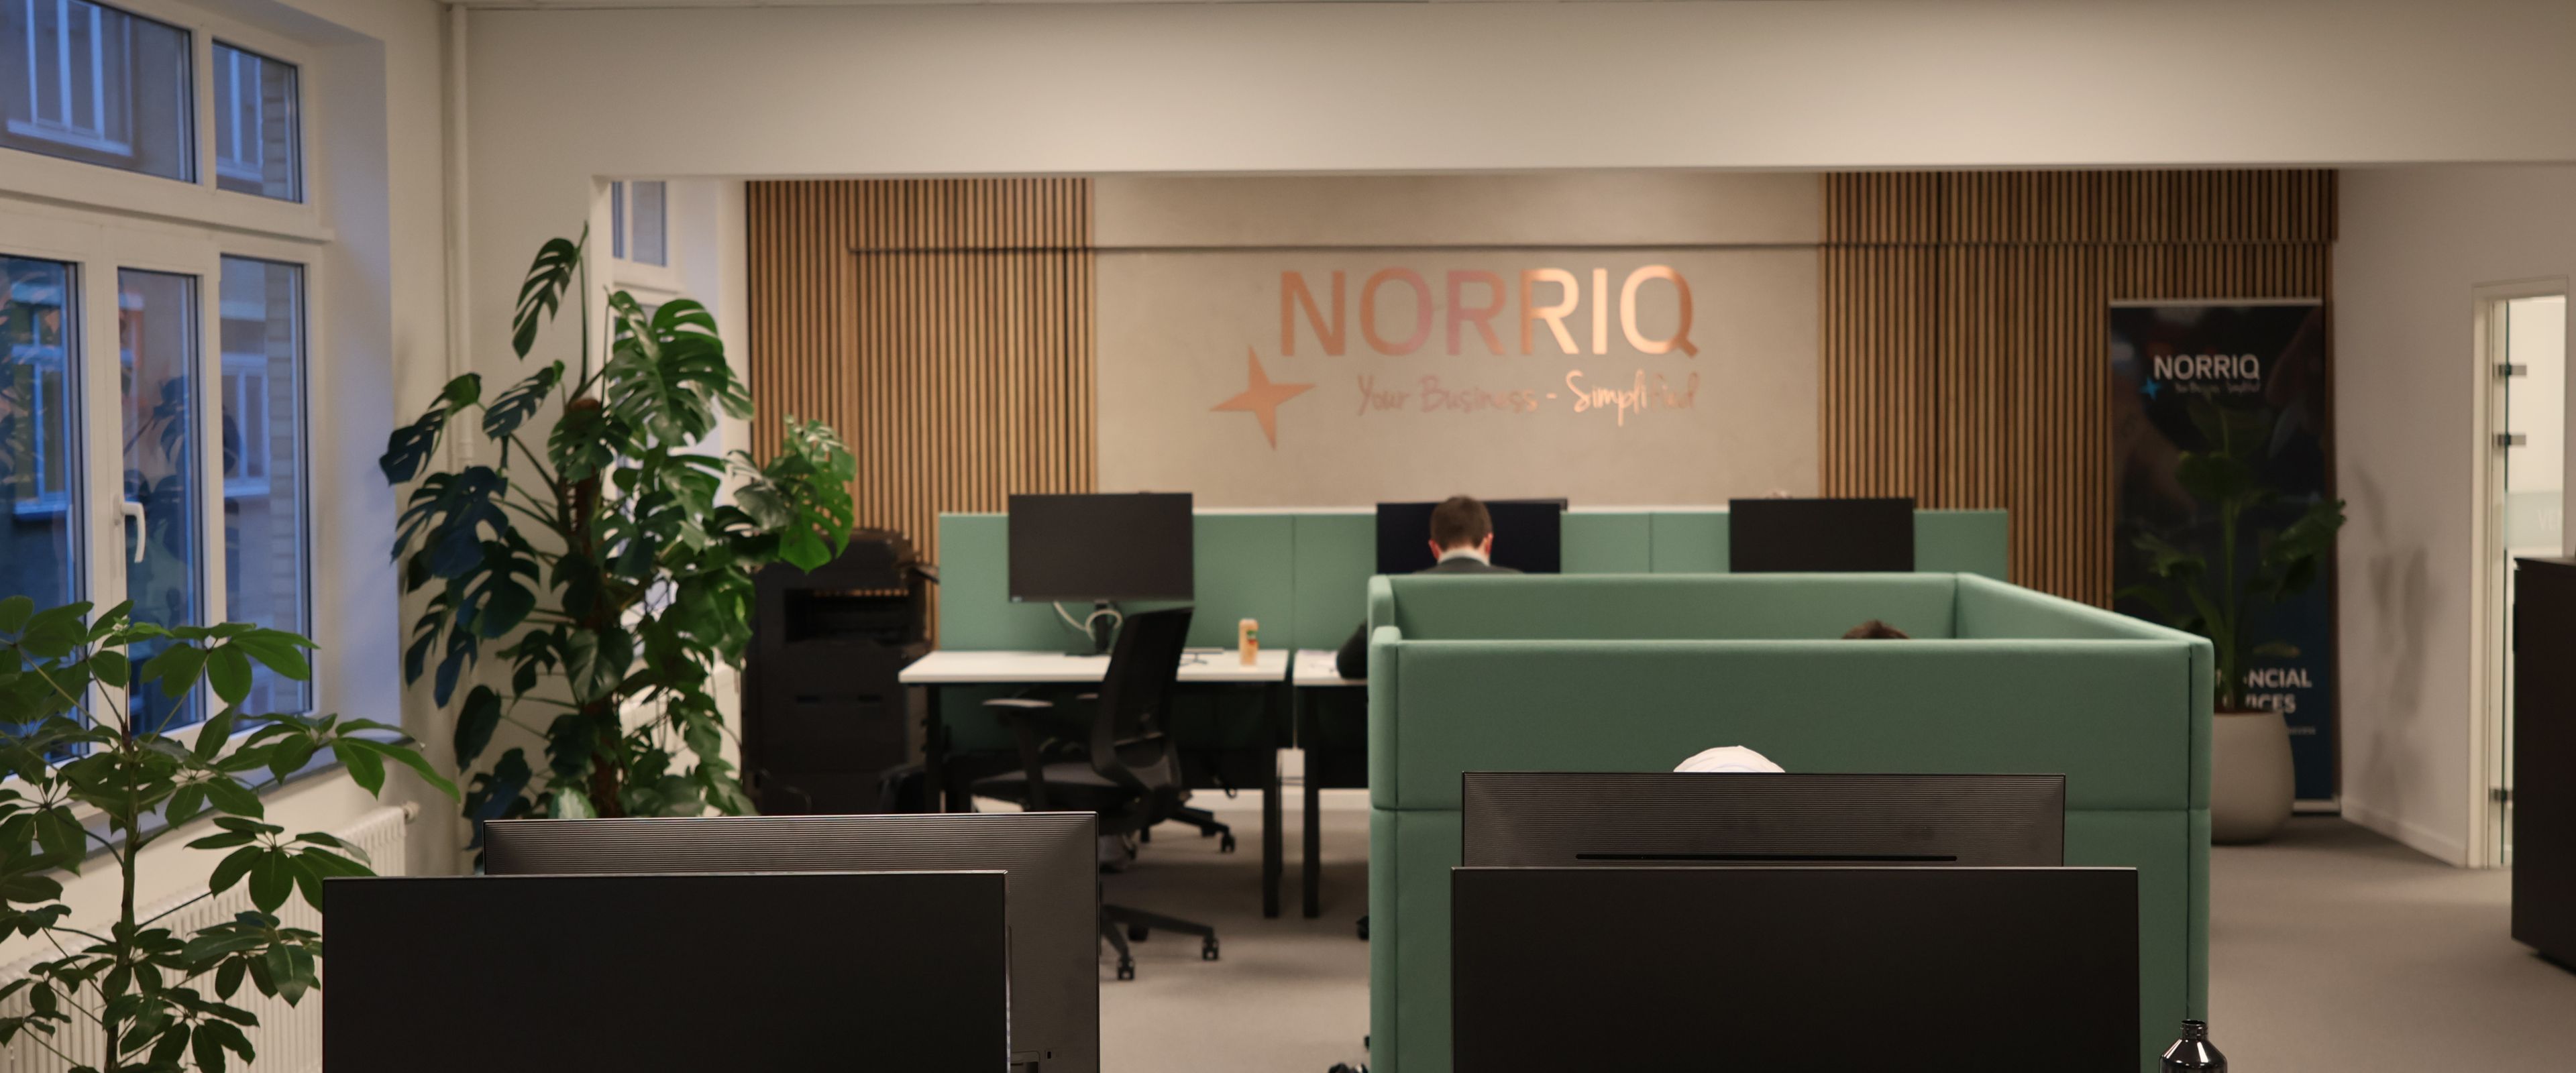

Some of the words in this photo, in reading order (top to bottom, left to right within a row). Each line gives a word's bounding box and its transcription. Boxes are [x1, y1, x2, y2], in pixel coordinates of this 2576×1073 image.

[1280, 266, 1699, 358] NORRIQ
[2153, 353, 2261, 380] NORRIQ
[1357, 374, 1409, 416] Your
[1418, 375, 1538, 414] Business
